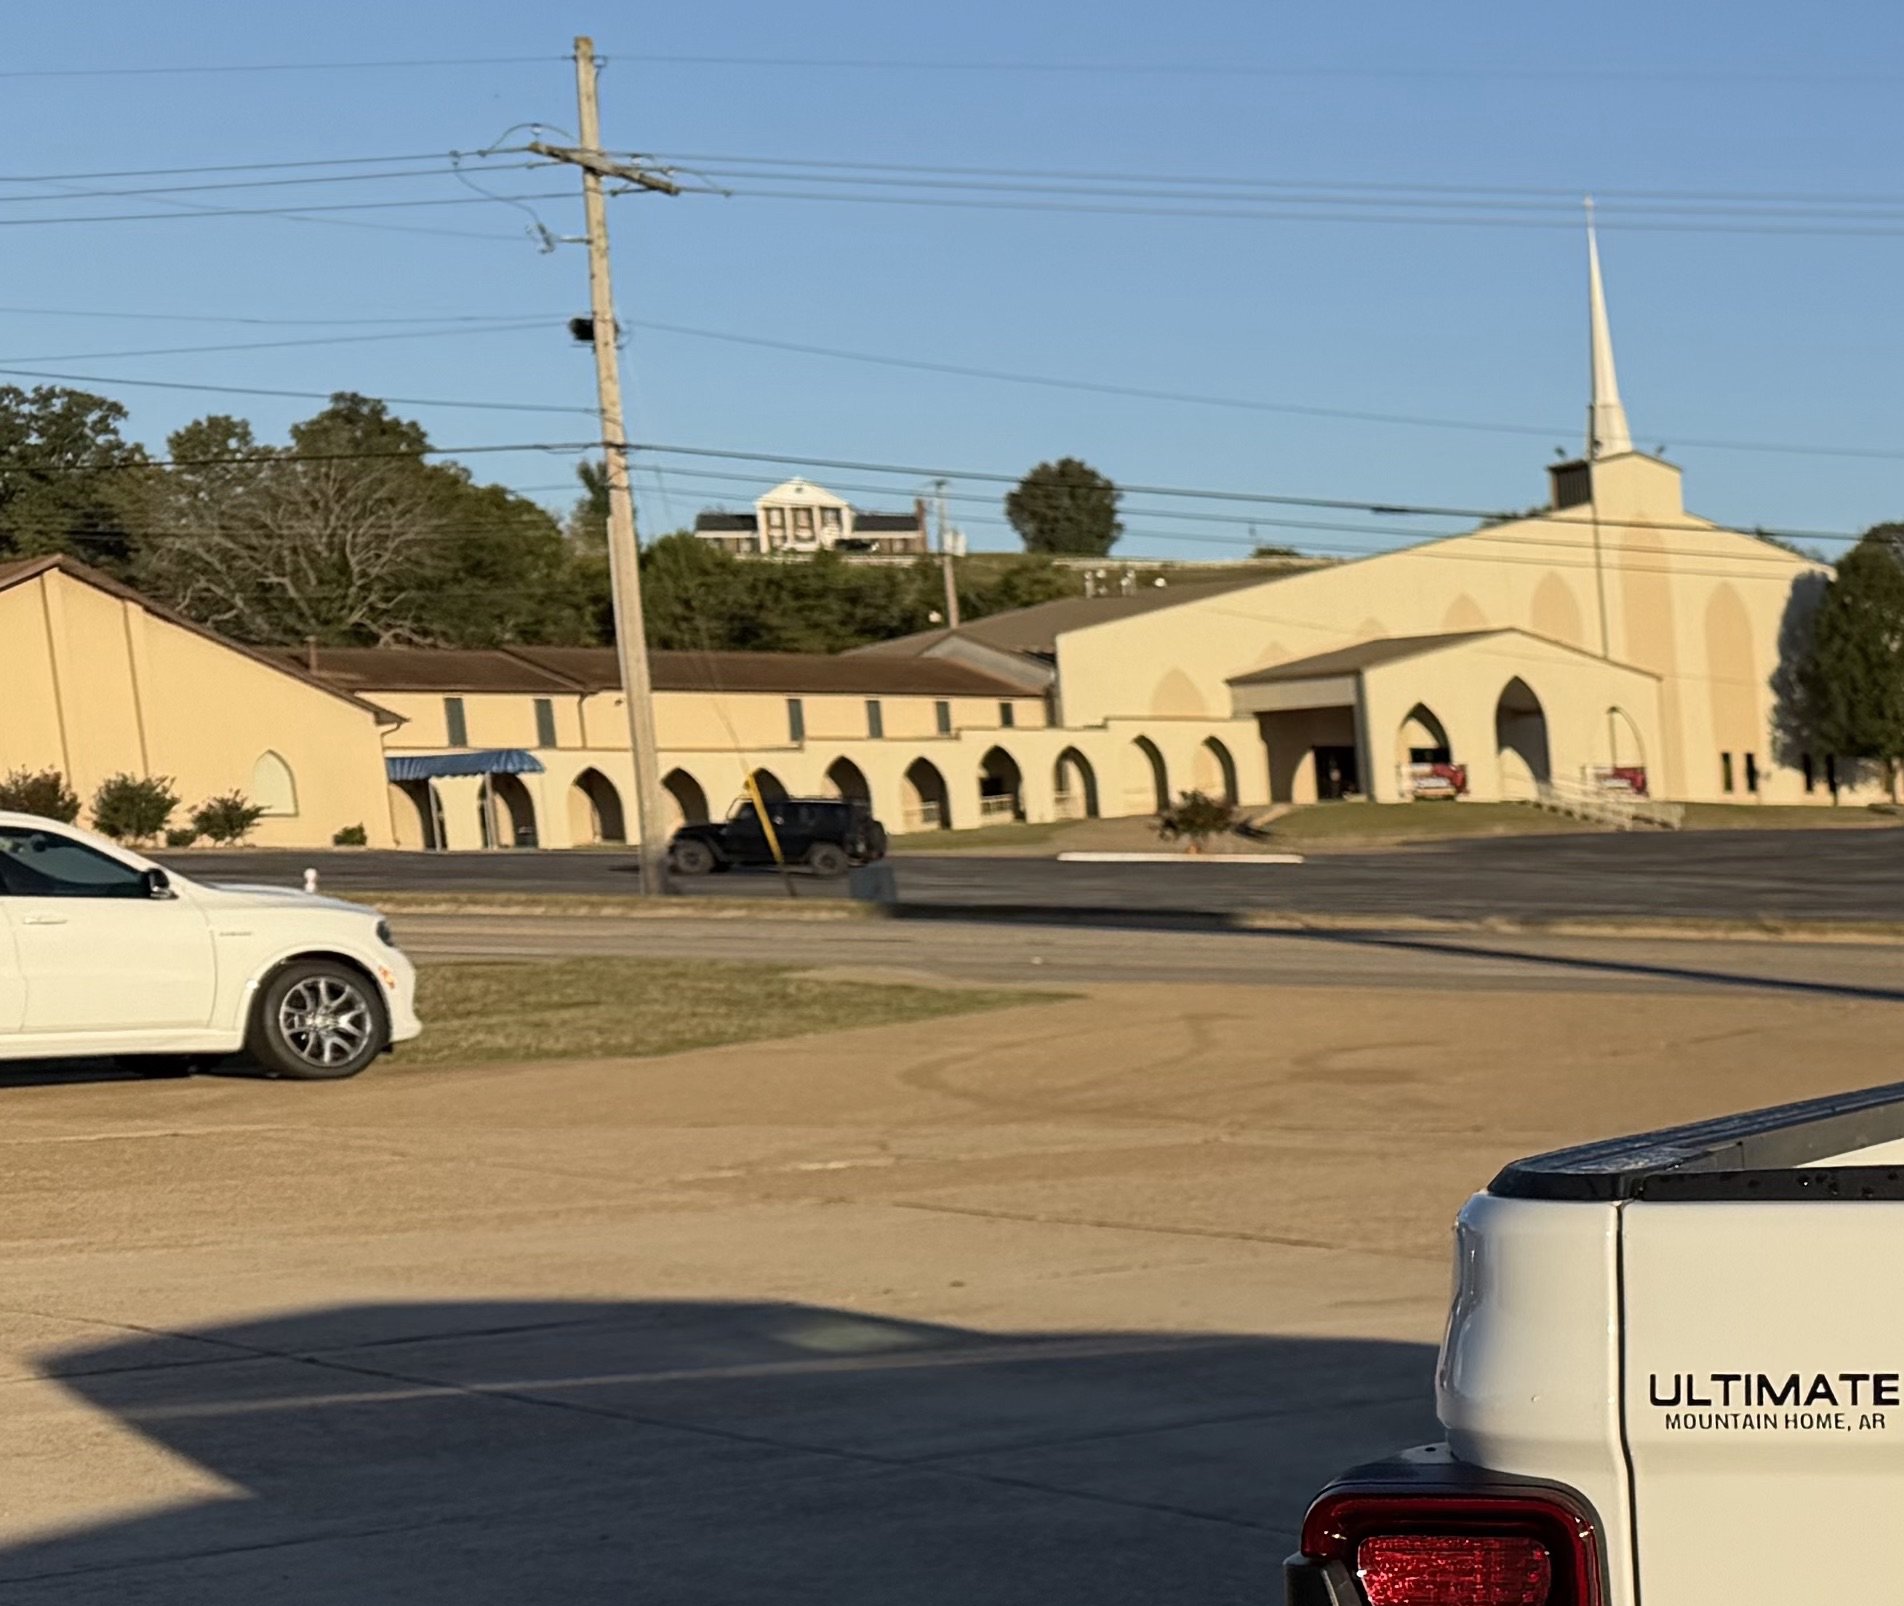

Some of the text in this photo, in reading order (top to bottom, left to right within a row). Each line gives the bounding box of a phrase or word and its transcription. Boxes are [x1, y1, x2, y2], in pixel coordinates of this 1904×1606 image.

[1649, 1373, 1900, 1407] ULTIMATE
[1665, 1412, 1886, 1432] MOUNTAIN HOME, AR
